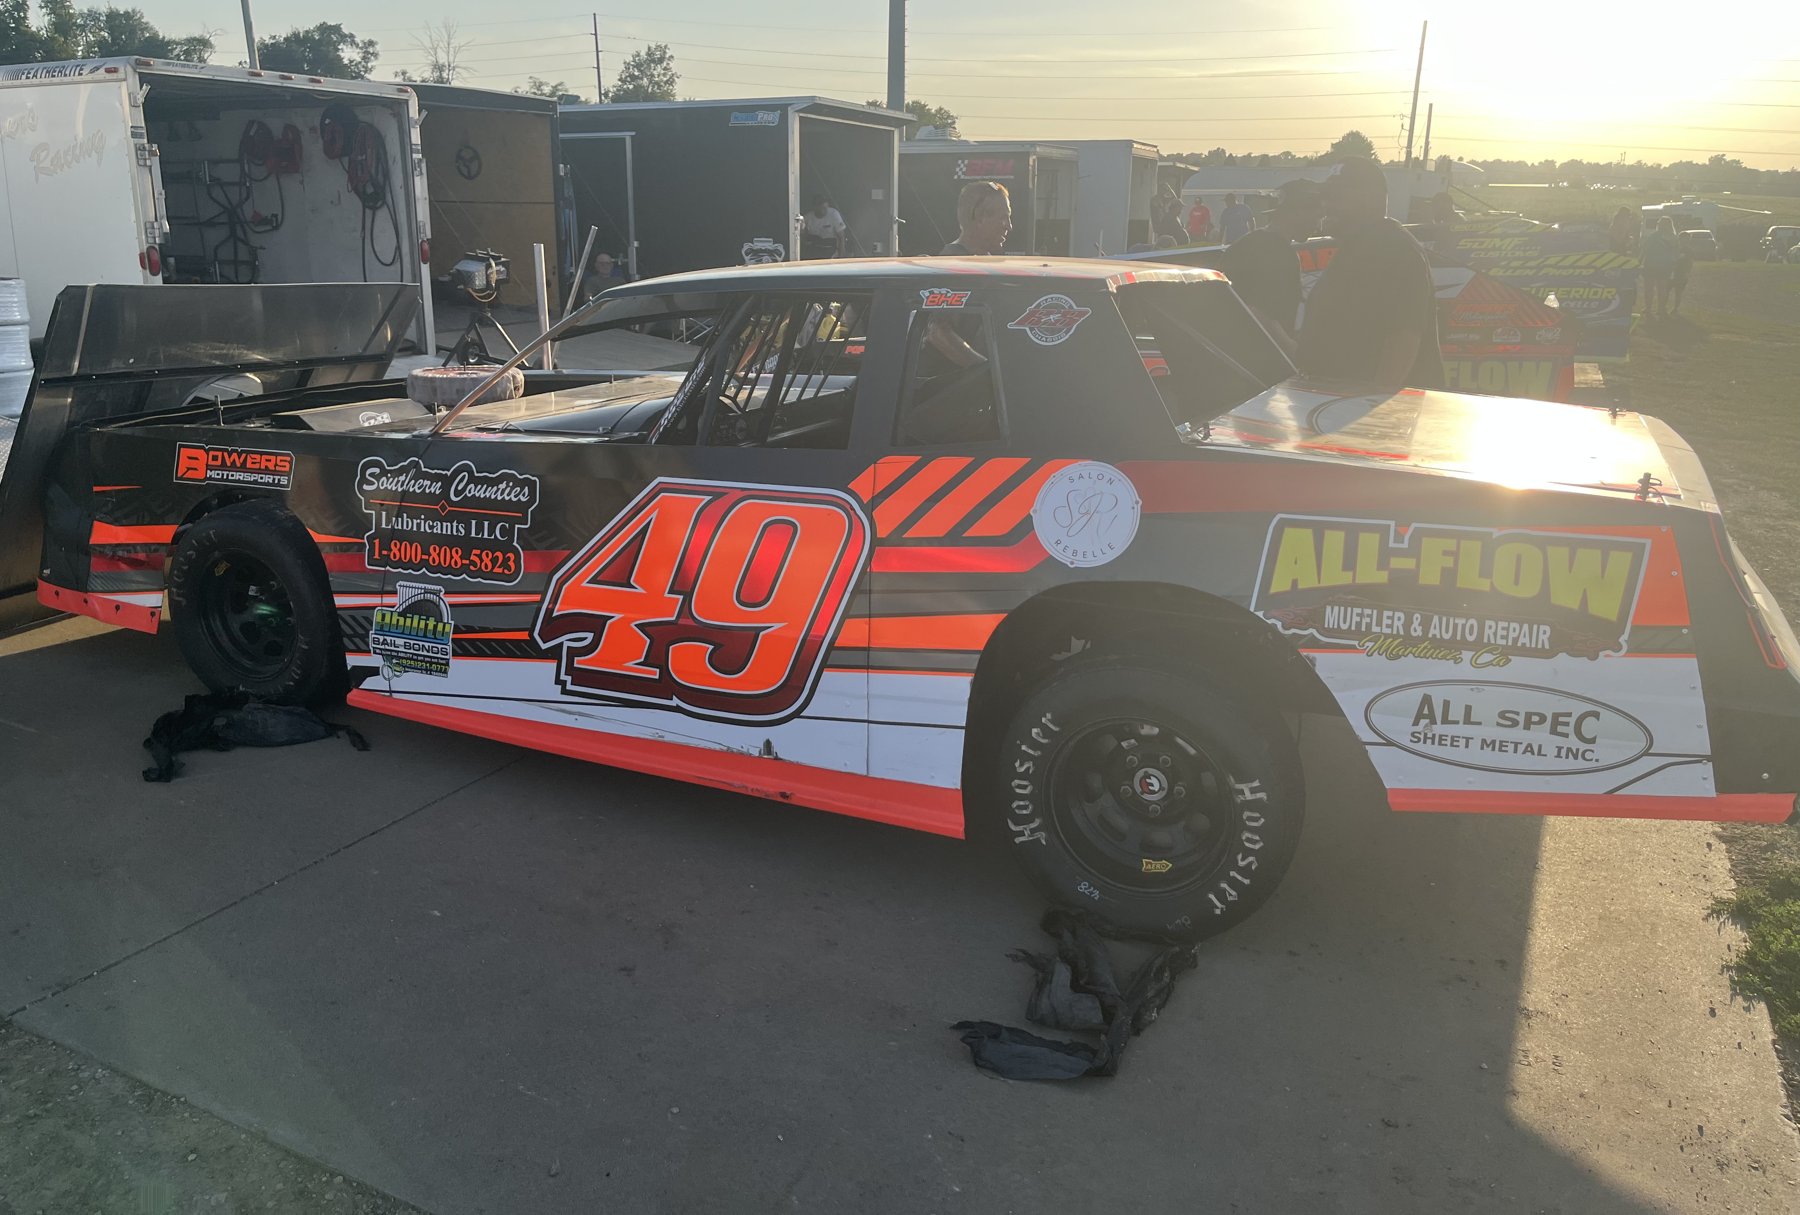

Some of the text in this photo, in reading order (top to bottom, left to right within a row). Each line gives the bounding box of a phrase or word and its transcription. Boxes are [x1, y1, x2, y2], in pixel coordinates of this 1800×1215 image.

[20, 64, 86, 80] FEATHERLITE
[30, 130, 107, 184] Racing
[178, 447, 291, 479] BOWERS
[207, 470, 289, 485] MOTORSPORTS
[1068, 472, 1115, 486] SALON
[363, 467, 530, 501] Southern Counties
[381, 511, 509, 541] Lubricants LLC
[373, 538, 516, 575] 1-800-808-5823
[1054, 538, 1116, 559] REBELLE
[1269, 526, 1633, 622] ALL-FLOW
[545, 488, 858, 702] 49
[374, 610, 452, 642] Ability
[1324, 605, 1552, 649] MUFFLER & AUTO REPAIR
[372, 637, 449, 656] BAIL BONDS
[1470, 645, 1512, 669] Ca
[1411, 693, 1601, 745] ALL SPEC
[1409, 731, 1600, 763] SHEET METAL INC.
[1007, 712, 1060, 846] Hoosier
[1208, 774, 1268, 915] Hoosier
[1145, 862, 1168, 871] AERO
